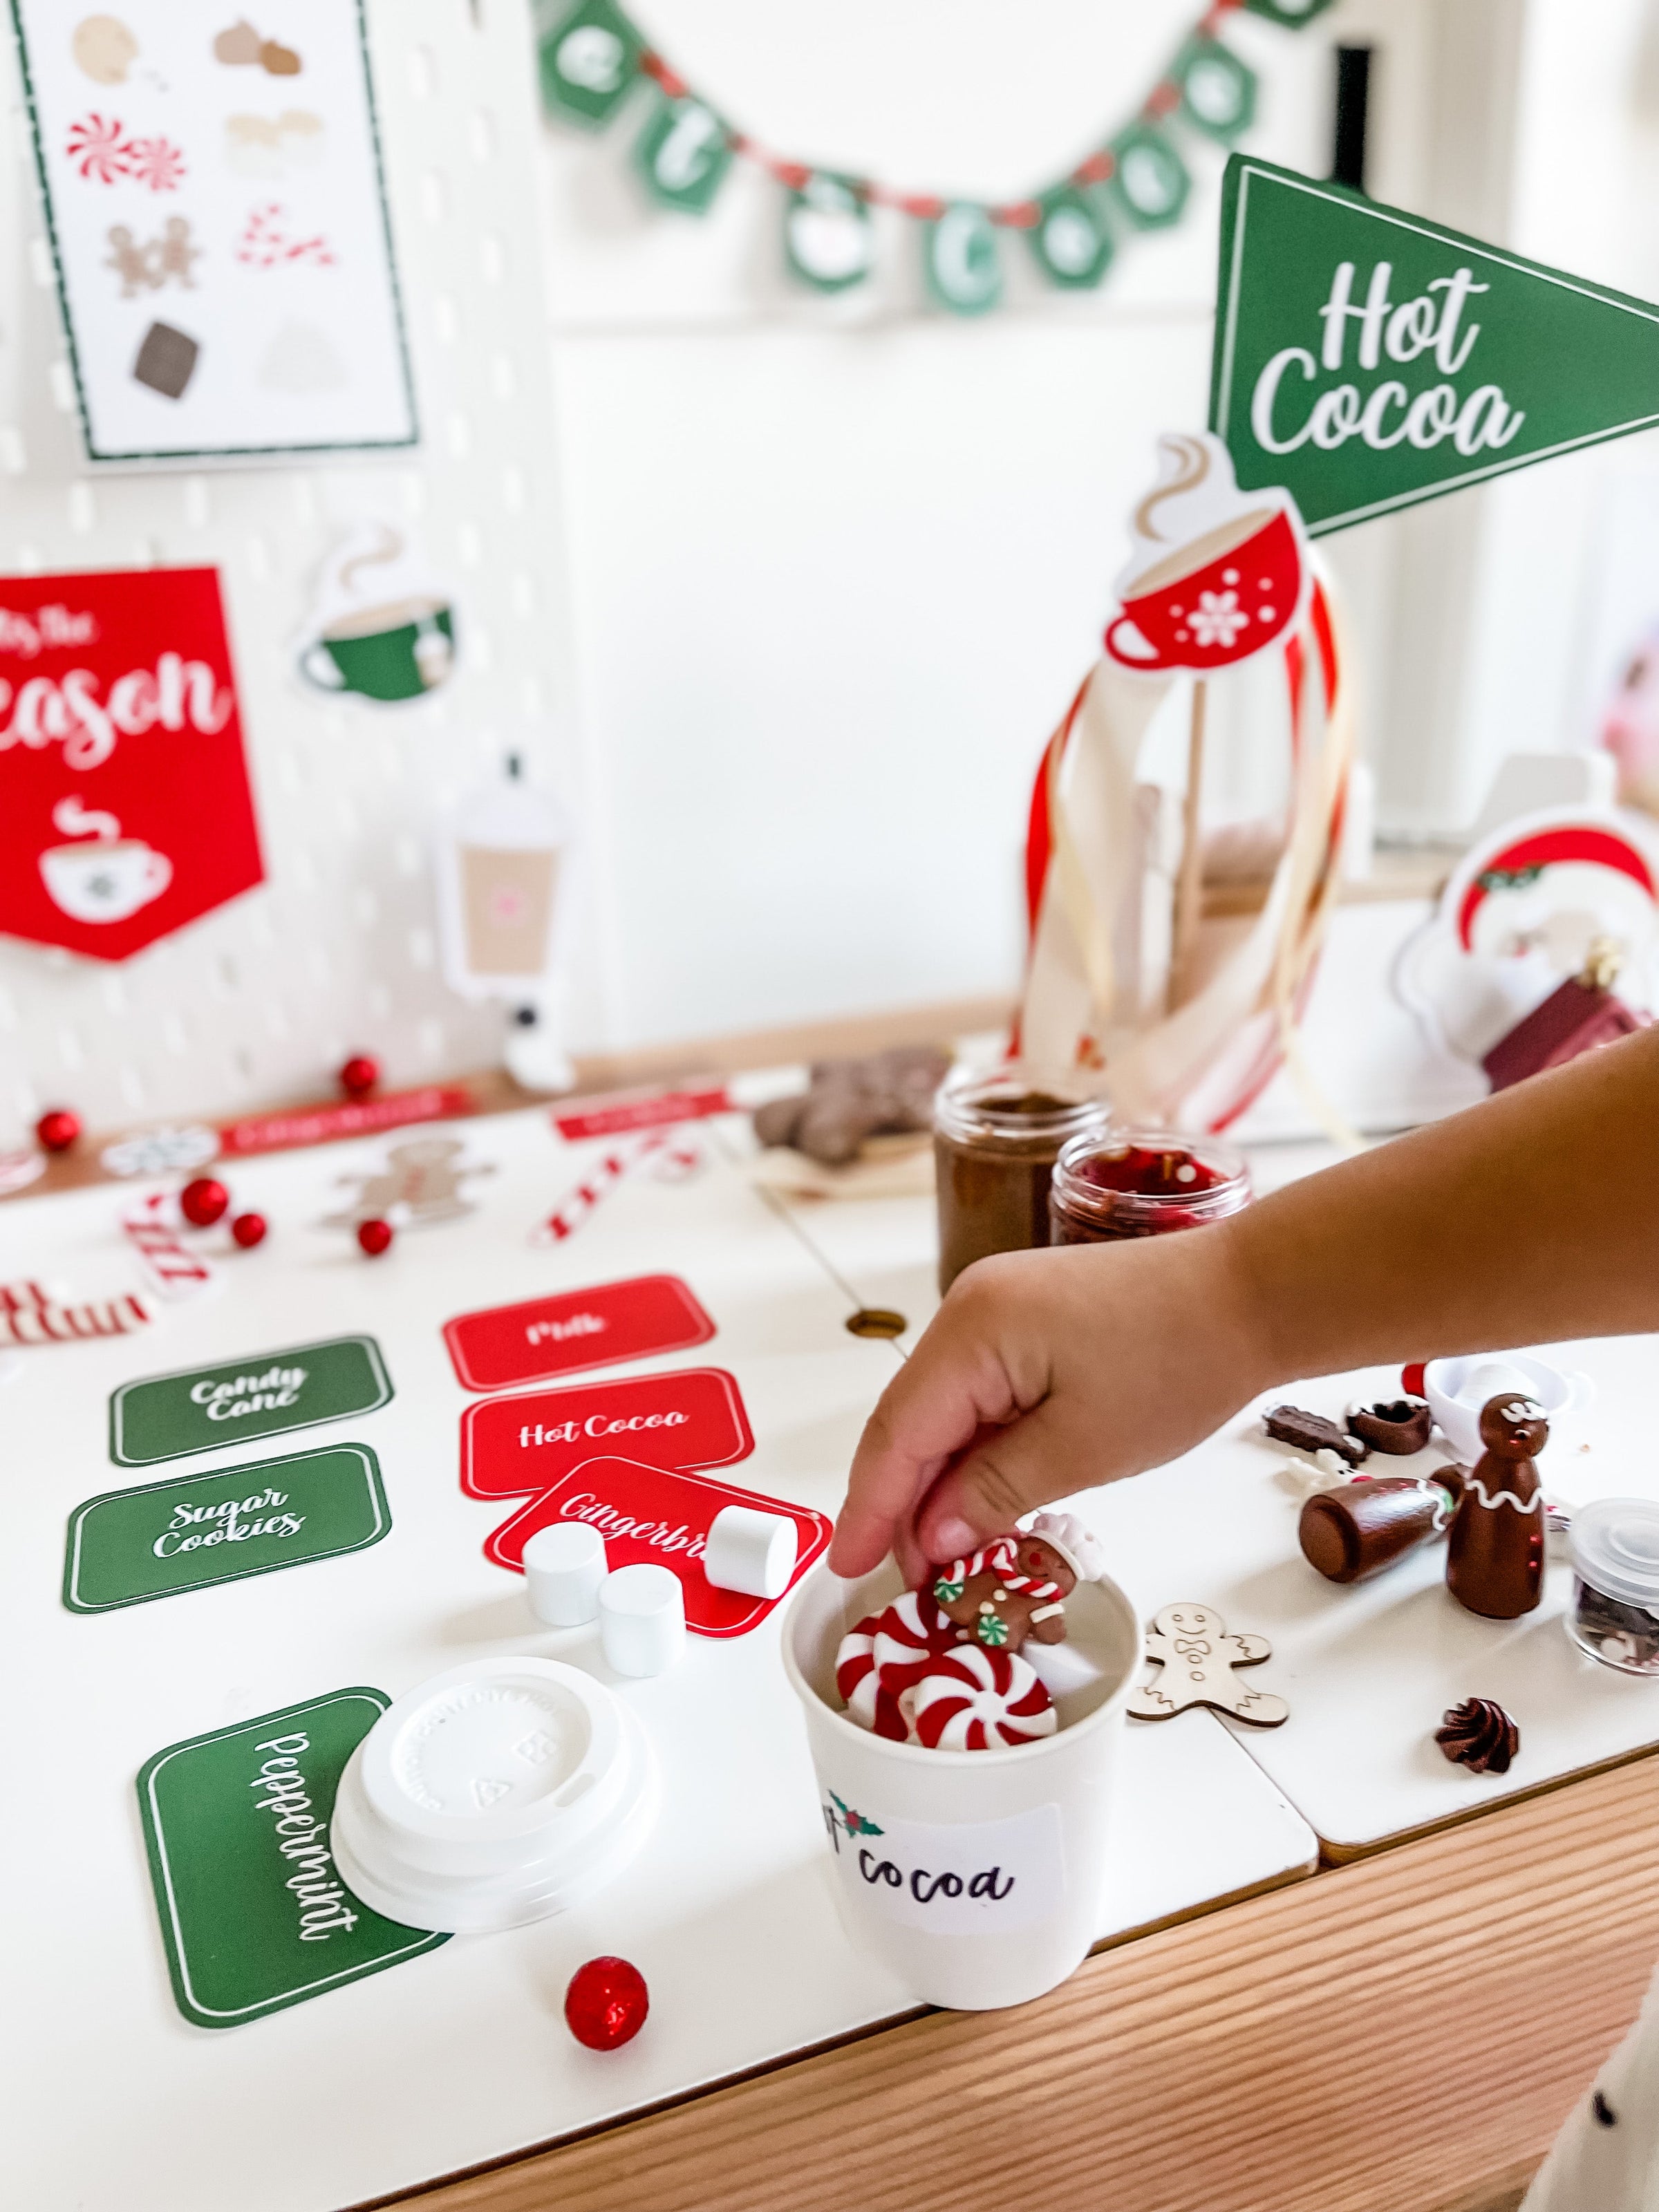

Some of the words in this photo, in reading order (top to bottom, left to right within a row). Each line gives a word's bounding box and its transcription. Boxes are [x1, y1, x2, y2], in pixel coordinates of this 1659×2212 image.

[1319, 261, 1490, 375] Hot
[1251, 347, 1526, 456] Cocoa
[190, 1367, 308, 1404] Candy
[207, 1392, 300, 1421] Cane
[517, 1421, 581, 1448] Hot
[584, 1411, 690, 1438] Cocoa
[168, 1488, 289, 1530] Sugar
[560, 1493, 706, 1562] Gingerbr
[153, 1512, 307, 1558] Cookies
[249, 1731, 359, 1941] Peppermint
[859, 1848, 1015, 1903] cocoa
